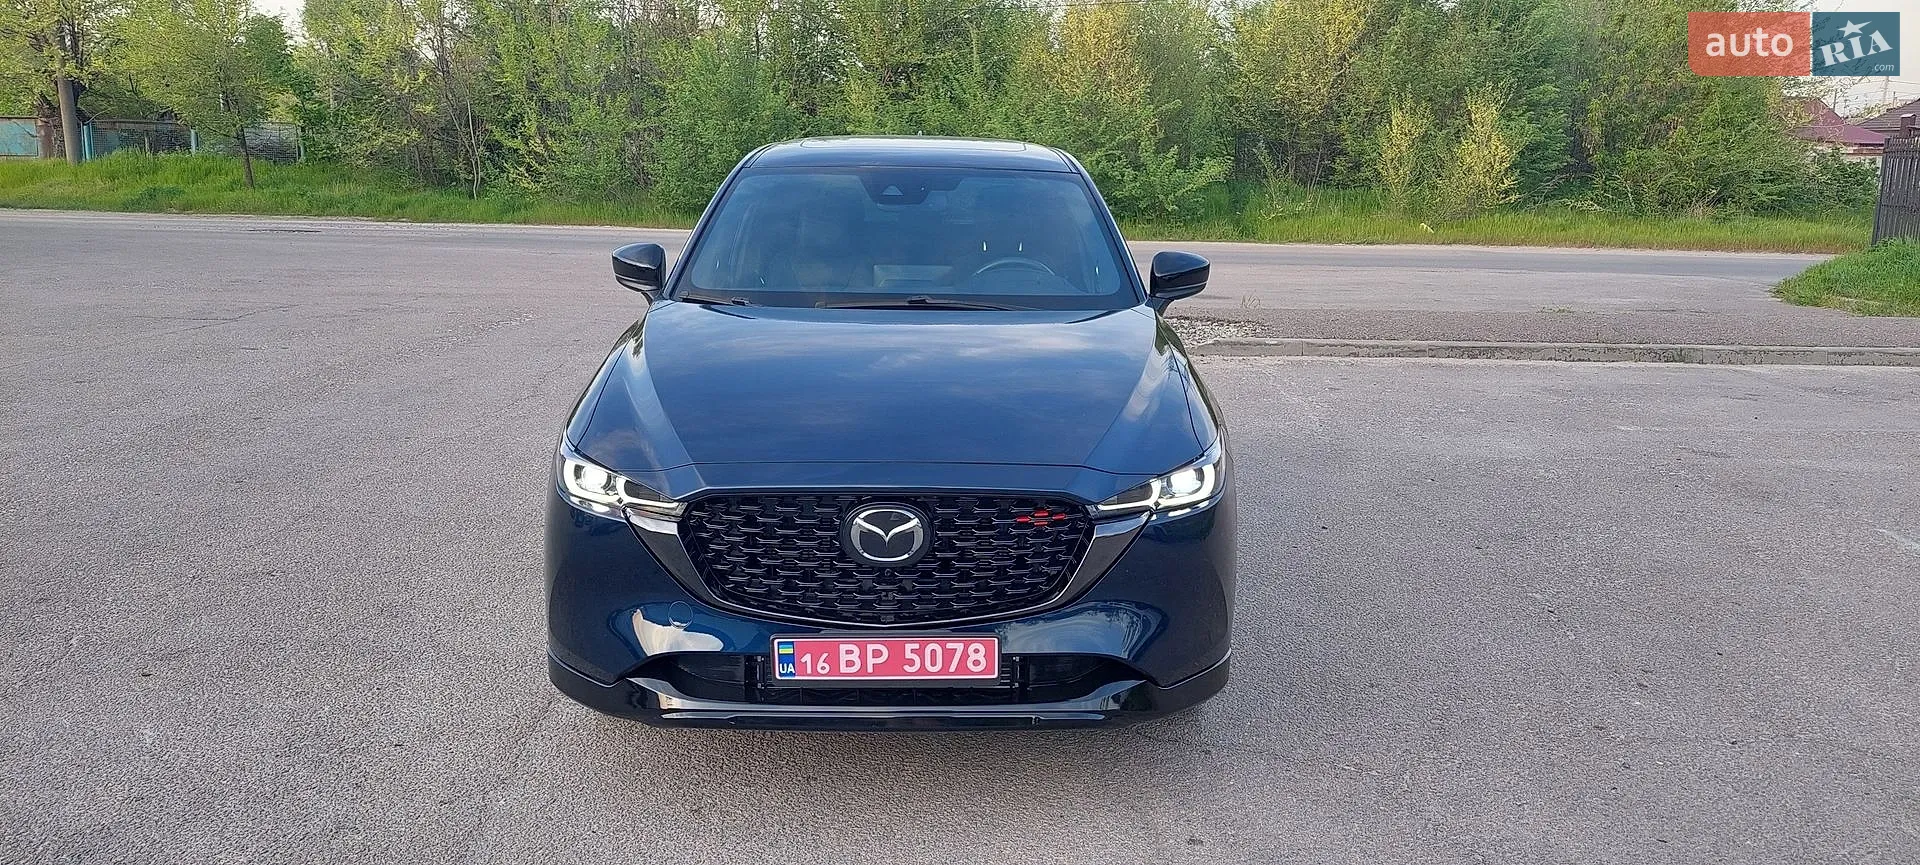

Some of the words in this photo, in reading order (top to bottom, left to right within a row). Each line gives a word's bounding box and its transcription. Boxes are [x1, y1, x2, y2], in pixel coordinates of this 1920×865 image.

[779, 664, 795, 674] UA
[800, 652, 831, 675] 16
[838, 643, 889, 673] BP
[902, 642, 987, 673] 5078
